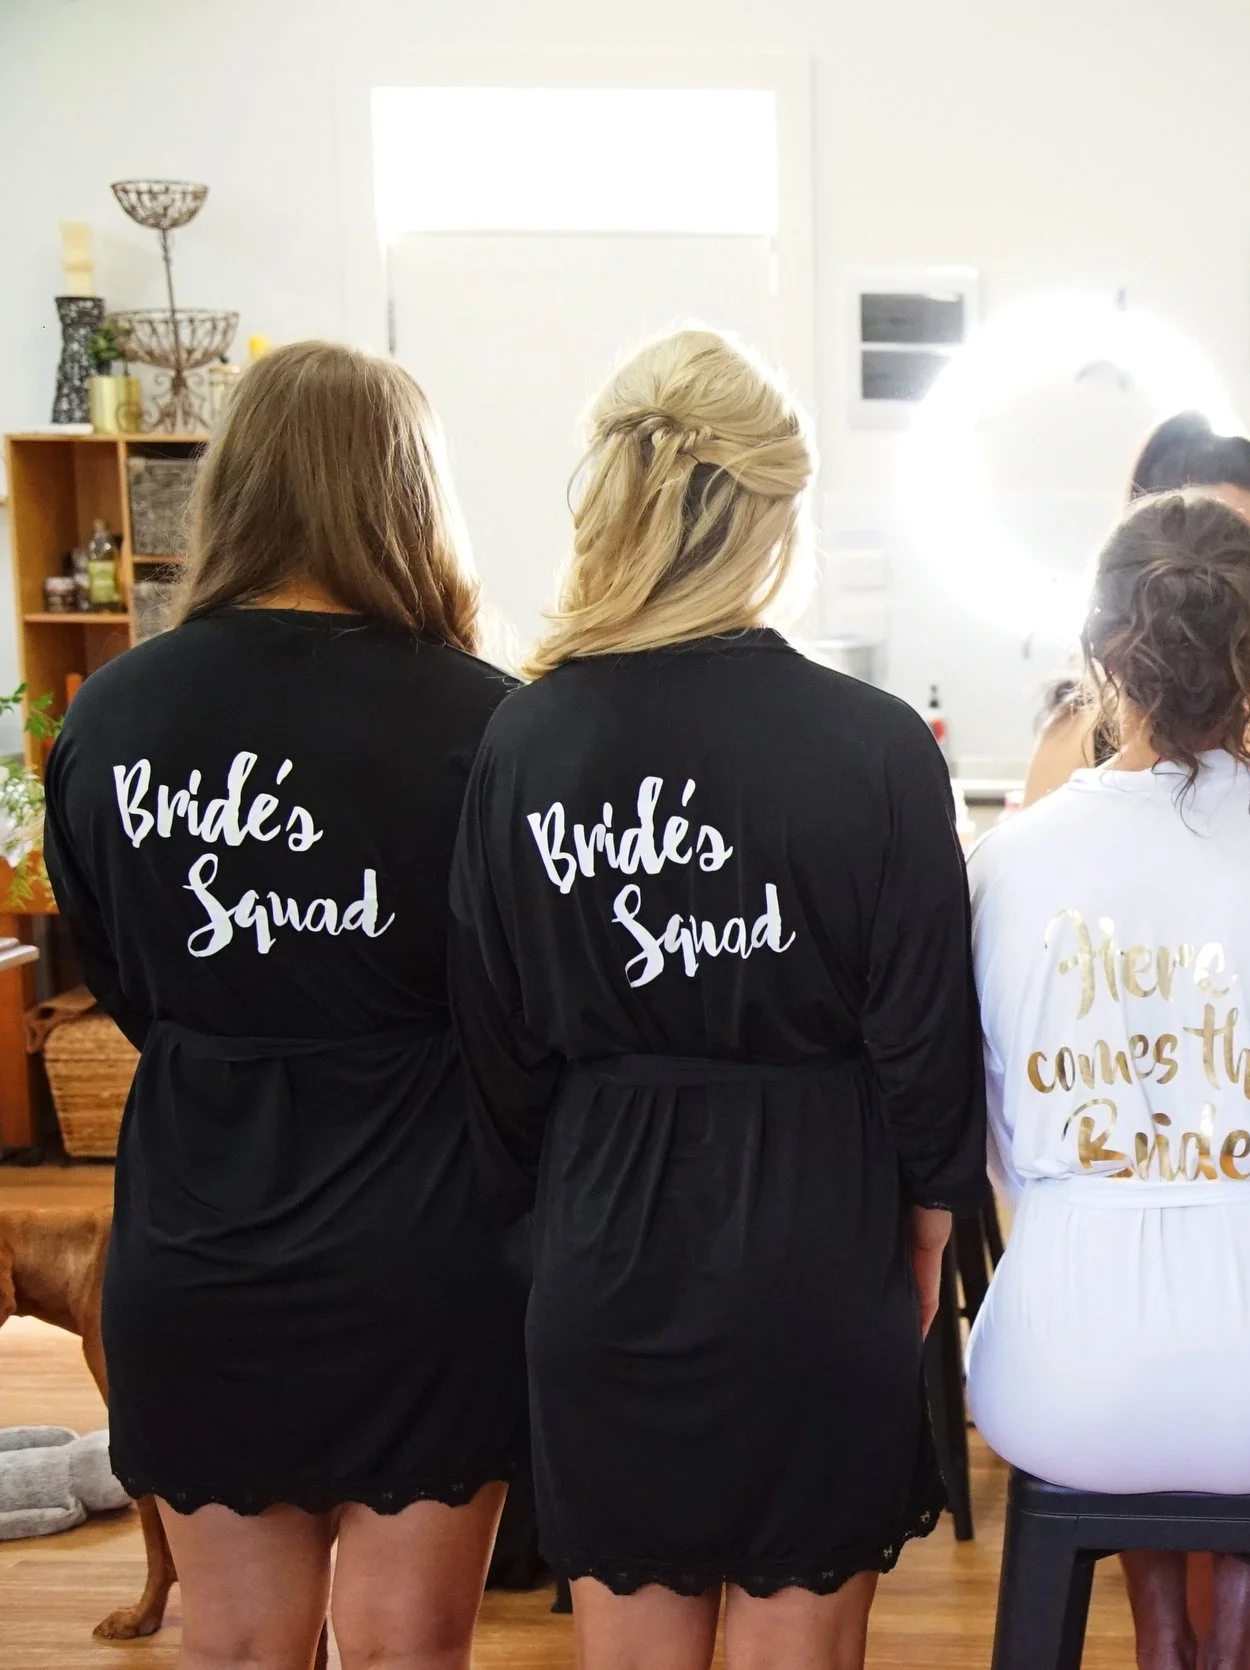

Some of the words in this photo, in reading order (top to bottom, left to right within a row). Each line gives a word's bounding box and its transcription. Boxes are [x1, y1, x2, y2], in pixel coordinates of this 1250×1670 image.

[112, 750, 324, 852] Bride's
[526, 775, 734, 895] Bride's
[182, 852, 396, 958] Squad
[611, 882, 797, 988] Squad
[1044, 908, 1238, 1020] Here
[1027, 1034, 1178, 1094] comes
